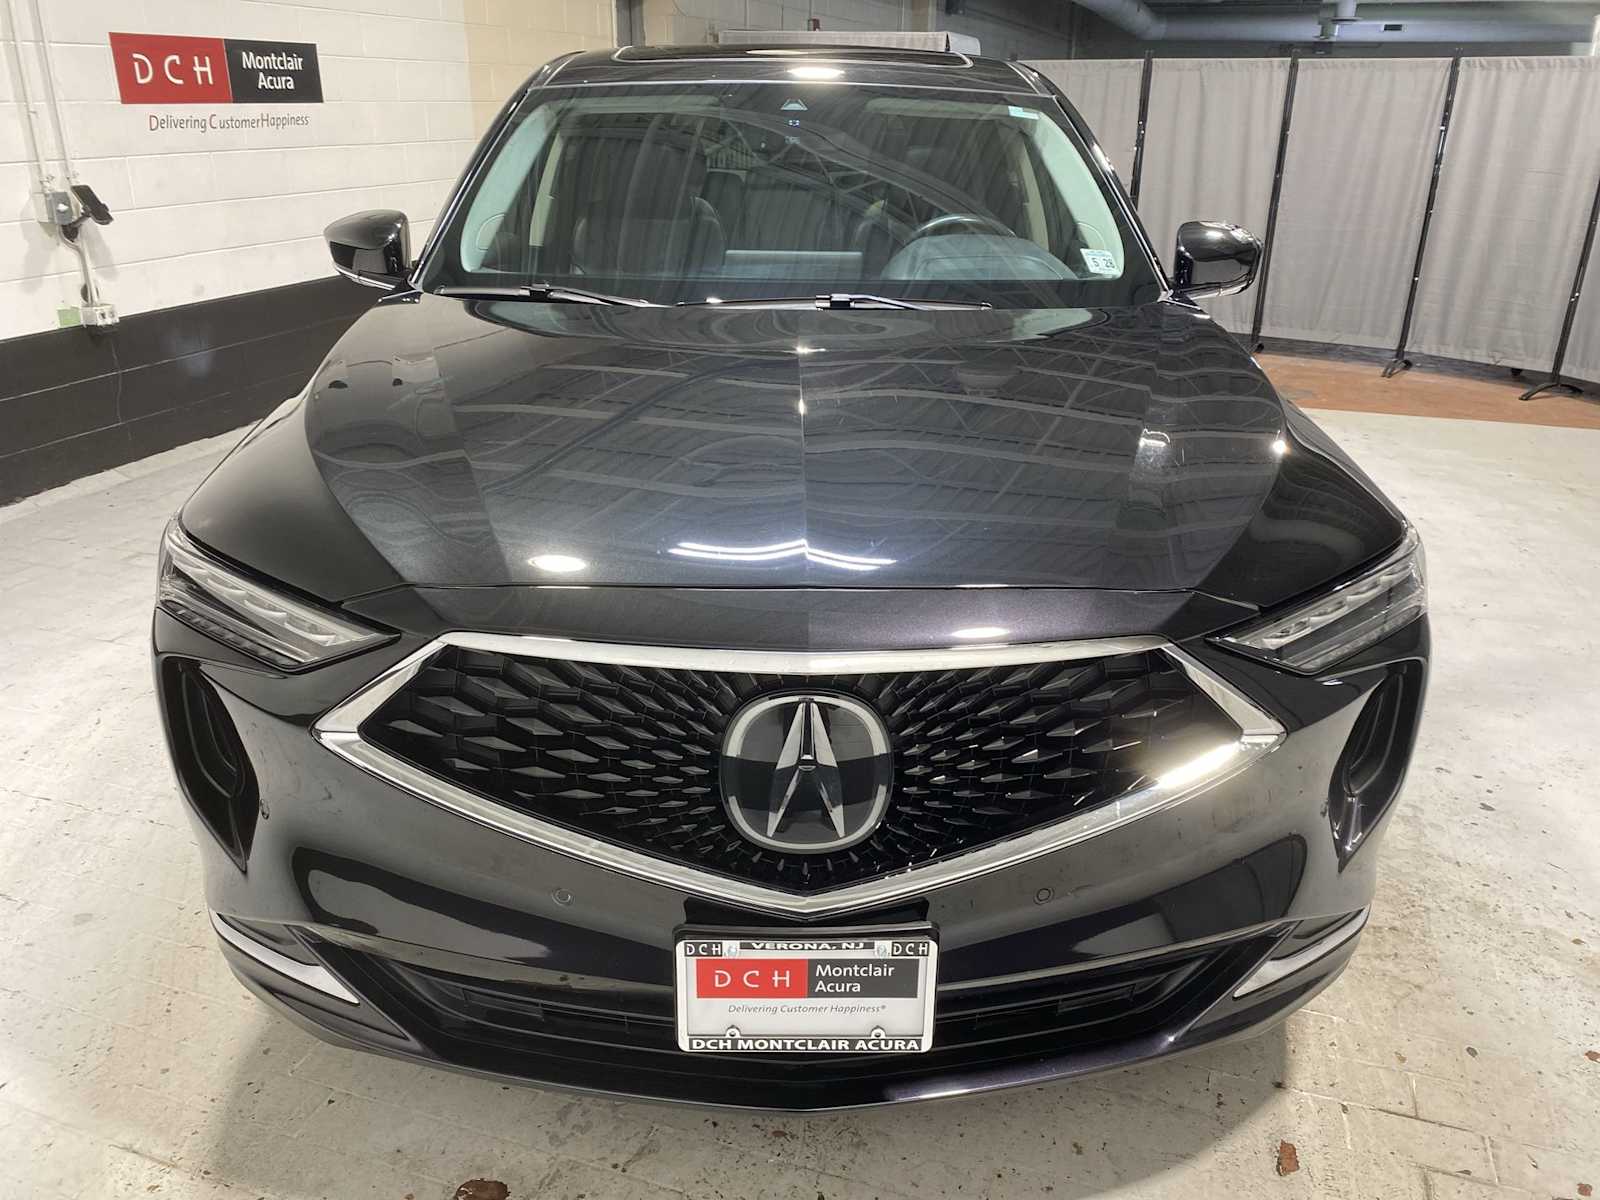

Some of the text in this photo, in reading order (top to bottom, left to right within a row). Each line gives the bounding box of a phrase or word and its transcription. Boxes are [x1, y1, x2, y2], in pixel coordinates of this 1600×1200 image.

[242, 51, 303, 71] Montclair
[132, 53, 214, 85] DCH
[257, 72, 294, 90] Acura
[149, 115, 207, 133] Delivering
[686, 943, 722, 956] DCH
[751, 942, 865, 950] VERONA, NJ
[893, 943, 928, 956] DCH
[815, 964, 895, 977] Montclair
[714, 970, 790, 988] DCH
[815, 980, 861, 993] Acura
[728, 1004, 778, 1015] Delivering
[780, 1004, 828, 1013] Customer
[692, 1039, 919, 1050] DCH MONTCLAIR ACURA
